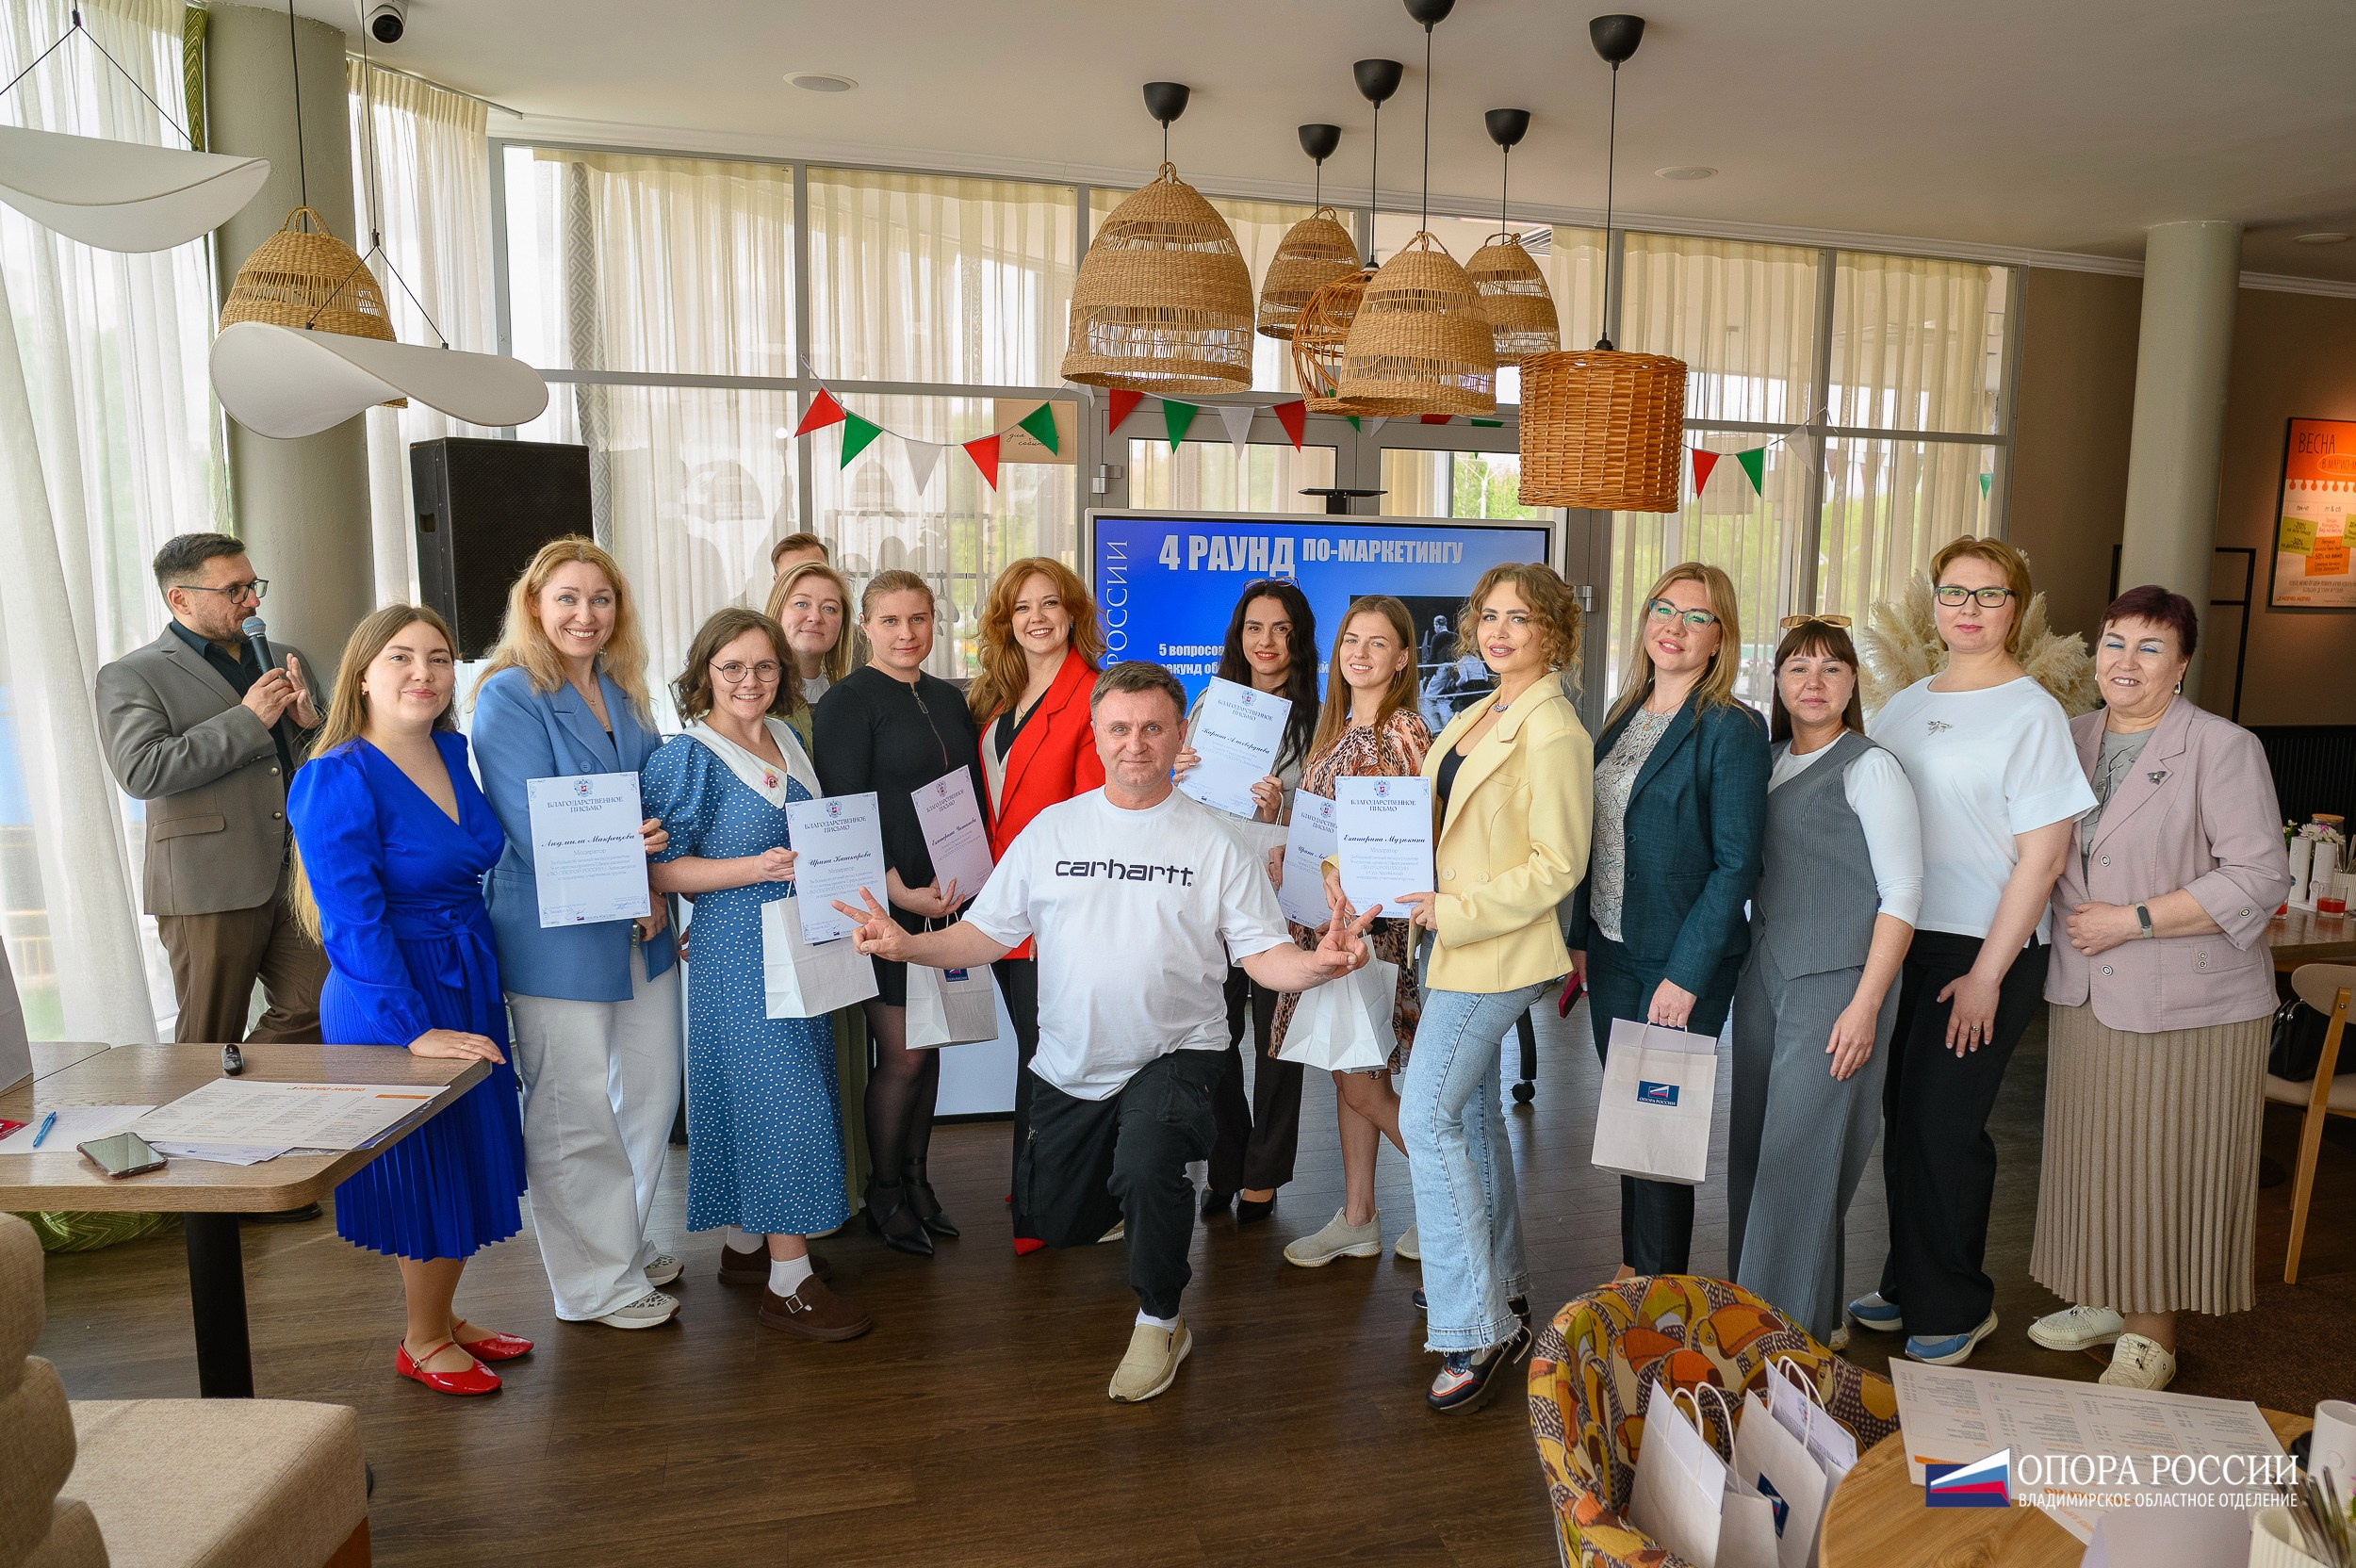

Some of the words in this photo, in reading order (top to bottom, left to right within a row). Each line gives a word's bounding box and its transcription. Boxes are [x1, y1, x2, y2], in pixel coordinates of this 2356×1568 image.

[2298, 433, 2335, 454] ВЕСНА
[1158, 534, 1181, 570] 4
[1188, 535, 1296, 578] РАУНД
[1302, 538, 1464, 564] ПО-МАРКЕТИНГУ
[1106, 540, 1128, 666] РОССИИ
[1158, 643, 1168, 657] 5
[1218, 699, 1273, 721] БЛАГОДАРСТВЕННОЕ
[1232, 710, 1256, 721] ПИСЬМО
[547, 796, 624, 808] БЛАГОДАРСТВЕННОЕ
[804, 816, 867, 830] БЛАГОДАРСТВЕННОЕ
[1301, 812, 1337, 828] БЛАГОДАРСТВЕ
[824, 825, 850, 834] ПИСЬМО
[1344, 834, 1383, 844] Екатерина
